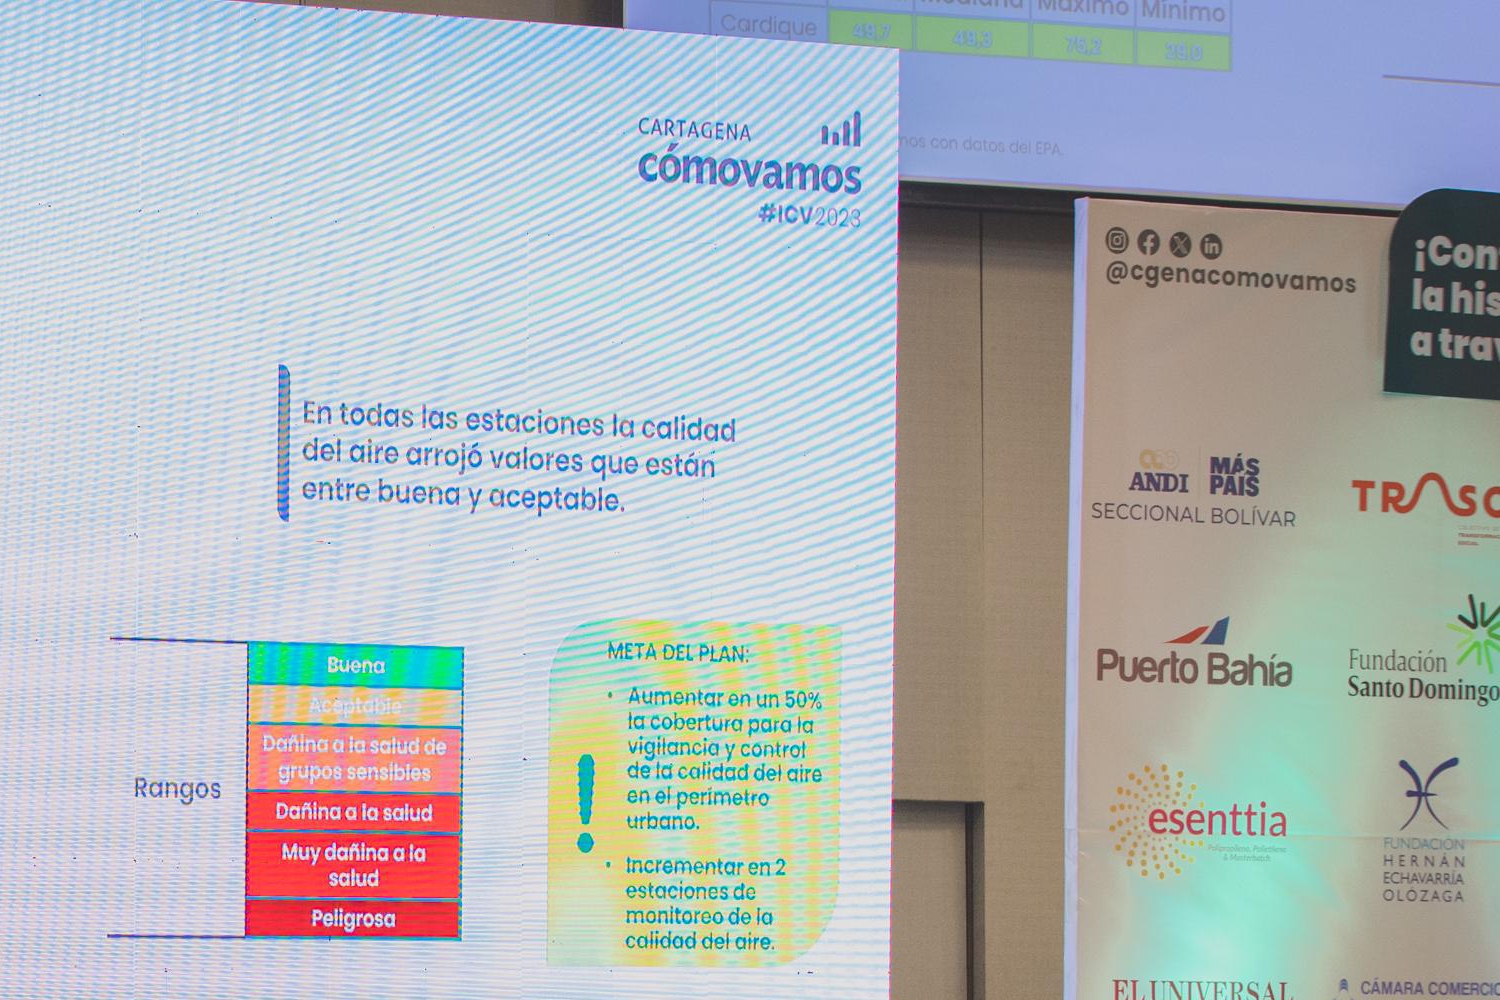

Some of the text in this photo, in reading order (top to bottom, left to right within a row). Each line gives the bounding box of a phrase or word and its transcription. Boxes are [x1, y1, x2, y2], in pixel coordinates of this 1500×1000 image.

[722, 13, 817, 38] Cardique
[638, 116, 752, 142] CARTAGENA
[930, 136, 958, 149] con
[963, 137, 1004, 152] datos
[1009, 138, 1031, 153] del
[638, 144, 862, 195] cómovamos
[758, 203, 861, 228] #ICV2023
[1106, 260, 1357, 293] @cgenacomovamos
[303, 401, 736, 443] En todas las estaciones la calidad
[302, 437, 716, 481] del aire arrojó valores que están
[1210, 453, 1260, 476] MÁS
[1129, 472, 1260, 497] ANDI PAÍS
[302, 478, 625, 517] entre buena y aceptable.
[1091, 502, 1296, 527] SECCIONAL BOLÍVAR
[608, 641, 750, 663] META DEL PLAN:
[1349, 648, 1448, 673] Fundación
[327, 656, 386, 674] Buena
[1096, 648, 1293, 688] Puerto Bahía
[1348, 675, 1500, 707] Santo Domingo
[262, 735, 447, 756] Dañina a la salud de
[278, 763, 432, 784] grupos sensibles
[134, 777, 221, 805] Rangos
[276, 802, 433, 822] Dañina a la salud
[1148, 801, 1287, 837] esenttia
[282, 843, 426, 865] Muy dañina a la
[1384, 836, 1465, 850] FUNDACIÓN
[1384, 853, 1466, 868] HERNÁN
[328, 869, 379, 887] salud
[1383, 869, 1464, 886] ECHAVARRÍA
[1383, 887, 1464, 903] OLÓZAGA
[311, 909, 396, 931] Peligrosa
[1361, 979, 1424, 995] CÁMARA
